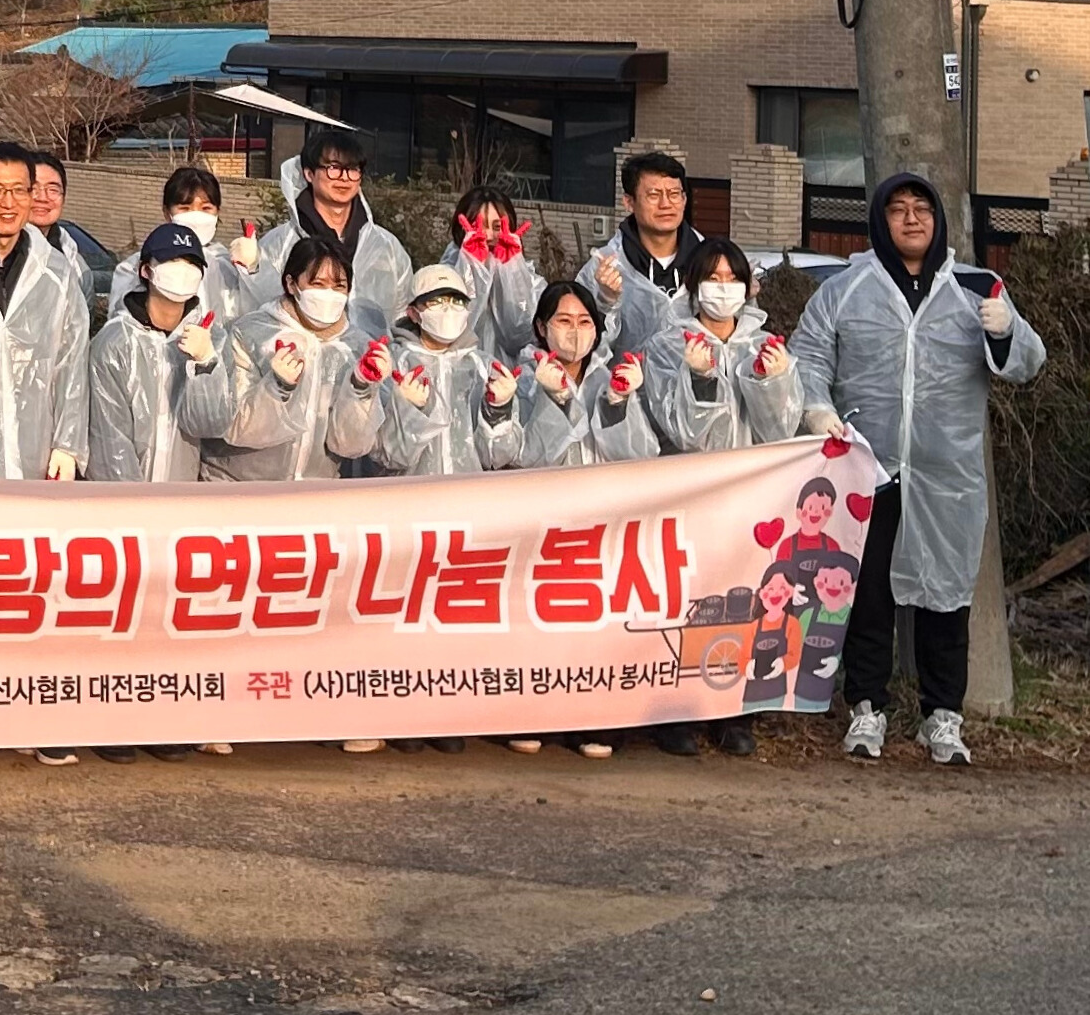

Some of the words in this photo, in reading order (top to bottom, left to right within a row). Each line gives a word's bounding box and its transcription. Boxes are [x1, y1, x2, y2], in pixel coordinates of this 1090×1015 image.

[173, 233, 192, 247] M
[173, 532, 340, 632] 연탄
[354, 529, 511, 624] 나눔
[531, 516, 689, 625] 봉사
[88, 671, 227, 704] 대전광역시회
[245, 670, 293, 701] 주관
[302, 666, 525, 701] (사)대한방사선사협회
[529, 664, 617, 696] 방사선사
[618, 659, 679, 691] 봉사단
